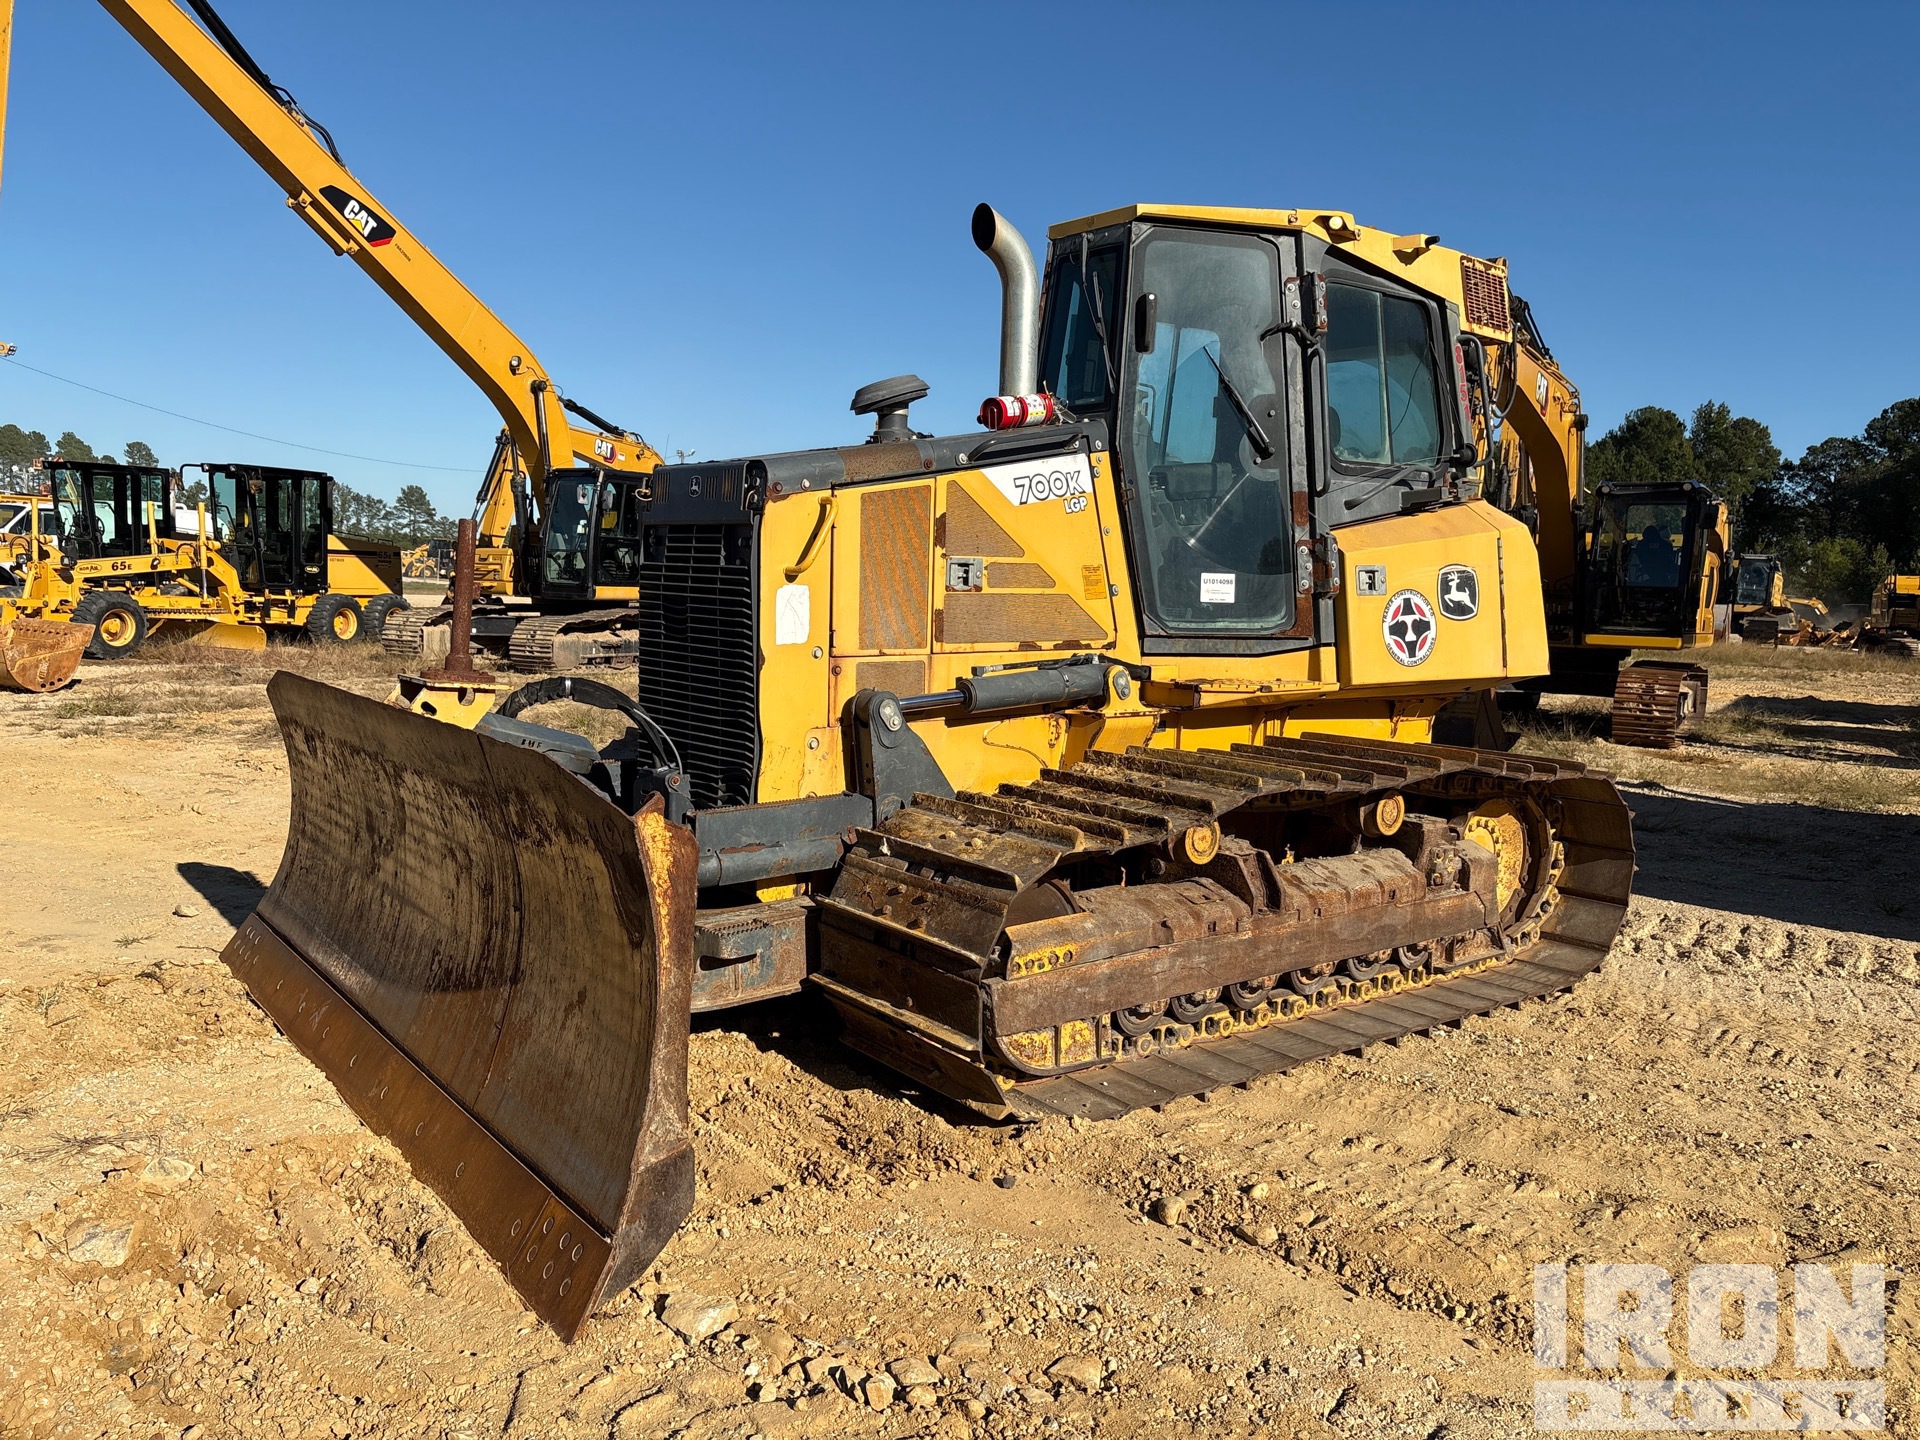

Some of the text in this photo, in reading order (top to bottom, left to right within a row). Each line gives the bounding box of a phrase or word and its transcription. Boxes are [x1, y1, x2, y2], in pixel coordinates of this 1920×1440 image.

[343, 199, 378, 238] CAT
[1454, 344, 1471, 422] 8151
[595, 438, 613, 459] CAT
[1013, 470, 1086, 505] 700K
[1063, 496, 1088, 514] LGP
[1394, 590, 1431, 607] CONSTRUCTION
[1386, 638, 1435, 665] GENERAL CONTRACTORS
